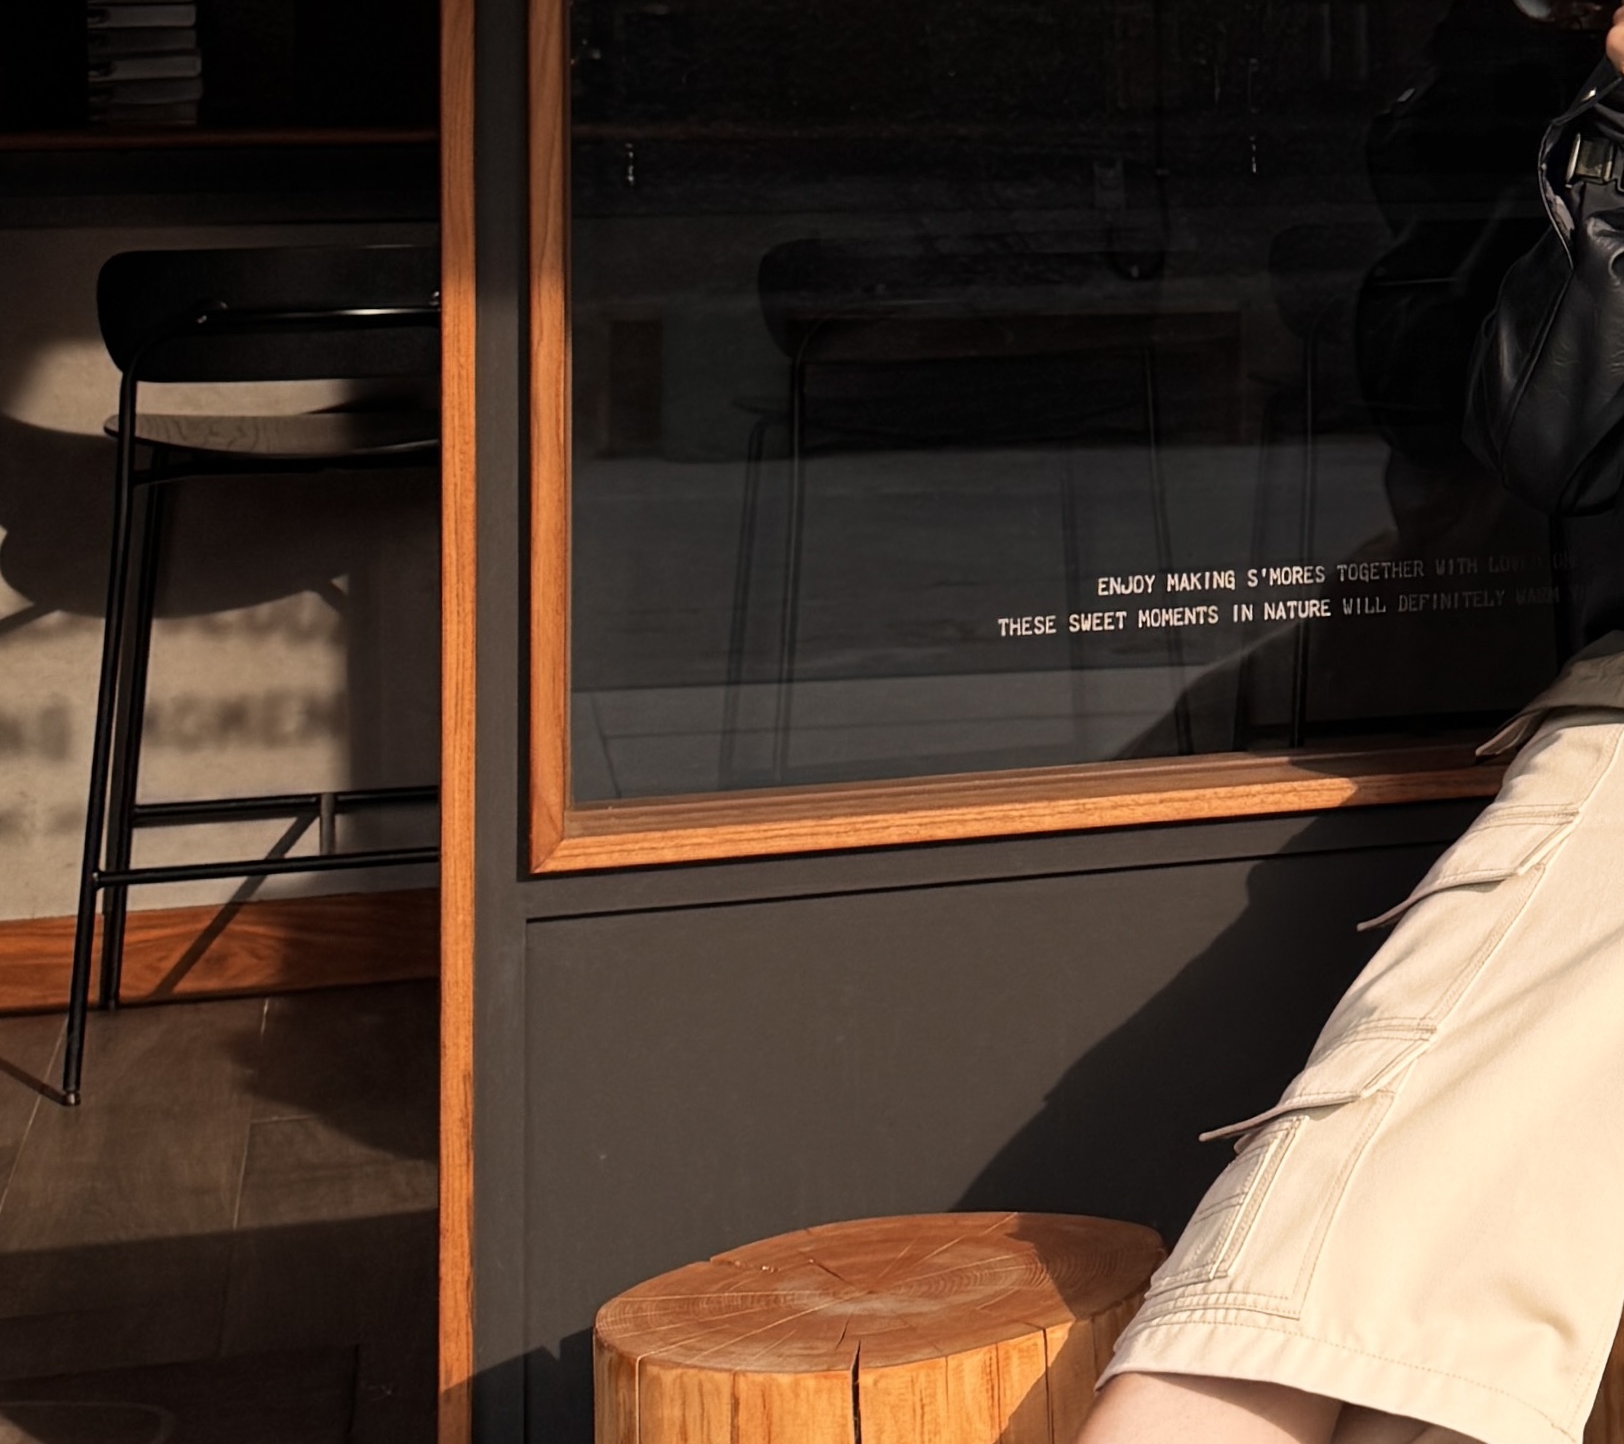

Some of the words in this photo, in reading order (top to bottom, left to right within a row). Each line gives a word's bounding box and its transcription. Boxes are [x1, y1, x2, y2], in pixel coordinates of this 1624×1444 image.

[1097, 574, 1156, 596] ENJOY
[1166, 569, 1236, 593] MAKING
[1247, 565, 1326, 588] S'MORES
[1336, 560, 1425, 583] TOGETHER
[1435, 557, 1478, 576] WITH
[997, 614, 1057, 637] THESE
[1068, 610, 1128, 633] SWEET
[1137, 604, 1219, 629] MOMENTS
[1232, 603, 1254, 623] IN
[1263, 599, 1332, 621] NATURE
[1342, 595, 1387, 616] WILL
[1398, 588, 1506, 614] DEFINITELY
